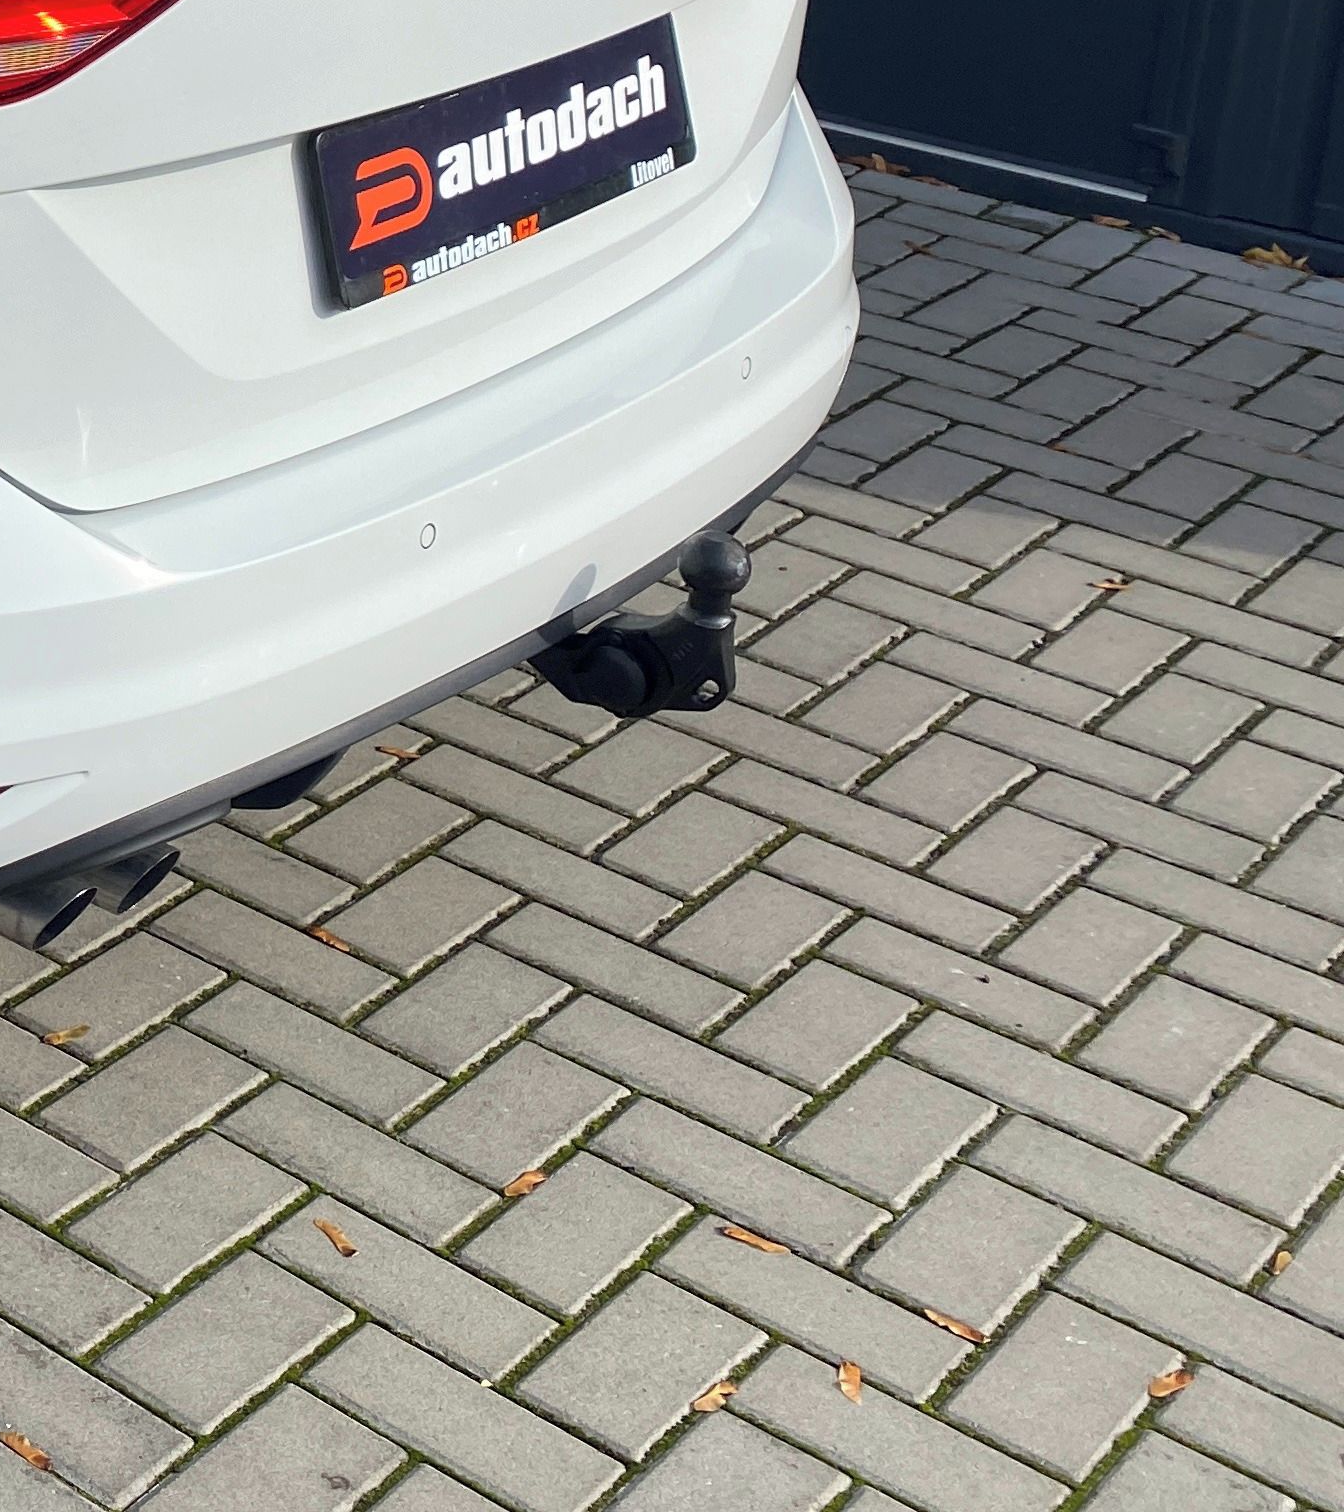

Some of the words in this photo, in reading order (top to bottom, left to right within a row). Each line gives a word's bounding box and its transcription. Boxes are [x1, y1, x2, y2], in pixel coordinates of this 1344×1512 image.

[436, 54, 668, 200] autodach
[630, 146, 676, 188] Litovel
[411, 213, 541, 284] autodach.cz
